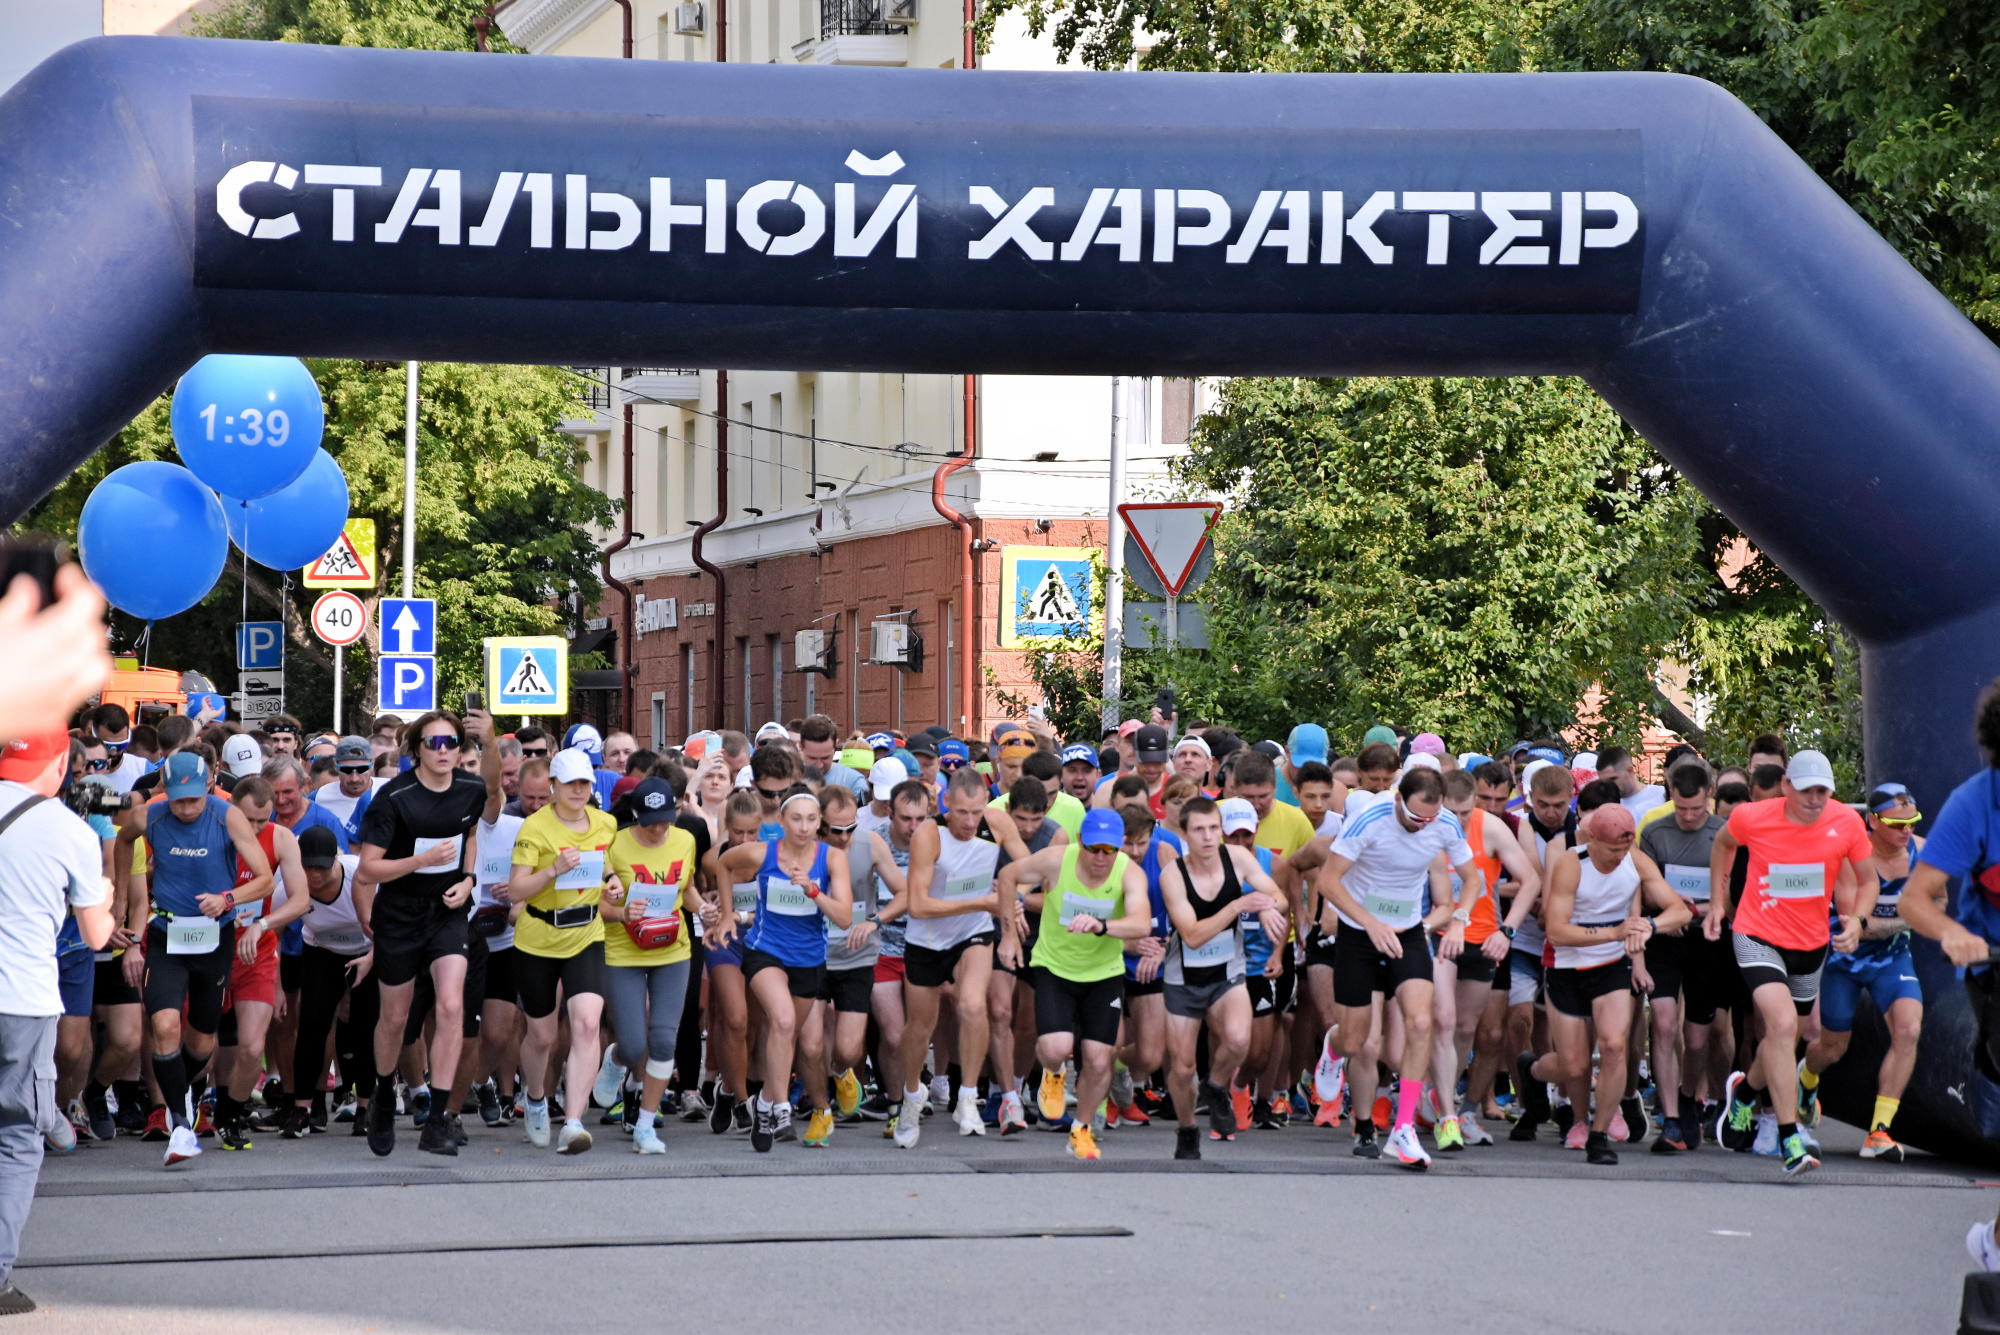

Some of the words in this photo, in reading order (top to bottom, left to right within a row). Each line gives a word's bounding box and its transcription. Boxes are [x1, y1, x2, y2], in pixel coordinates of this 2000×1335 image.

[216, 148, 919, 259] СТАЛЬНОЙ
[967, 185, 1640, 266] ХАРАКТЕР
[199, 403, 290, 448] 1:39
[325, 607, 353, 627] 40
[249, 627, 275, 663] P
[394, 662, 425, 705] P
[256, 703, 264, 712] 15
[266, 702, 280, 712] 20
[169, 846, 208, 857] BRIKO
[634, 867, 683, 884] ONE
[962, 881, 975, 891] 1111
[1680, 879, 1701, 889] 697
[1785, 877, 1809, 888] 1106
[779, 894, 805, 905] 1089
[1377, 902, 1400, 914] 1014
[1873, 906, 1896, 917] 522
[183, 931, 205, 943] 1167
